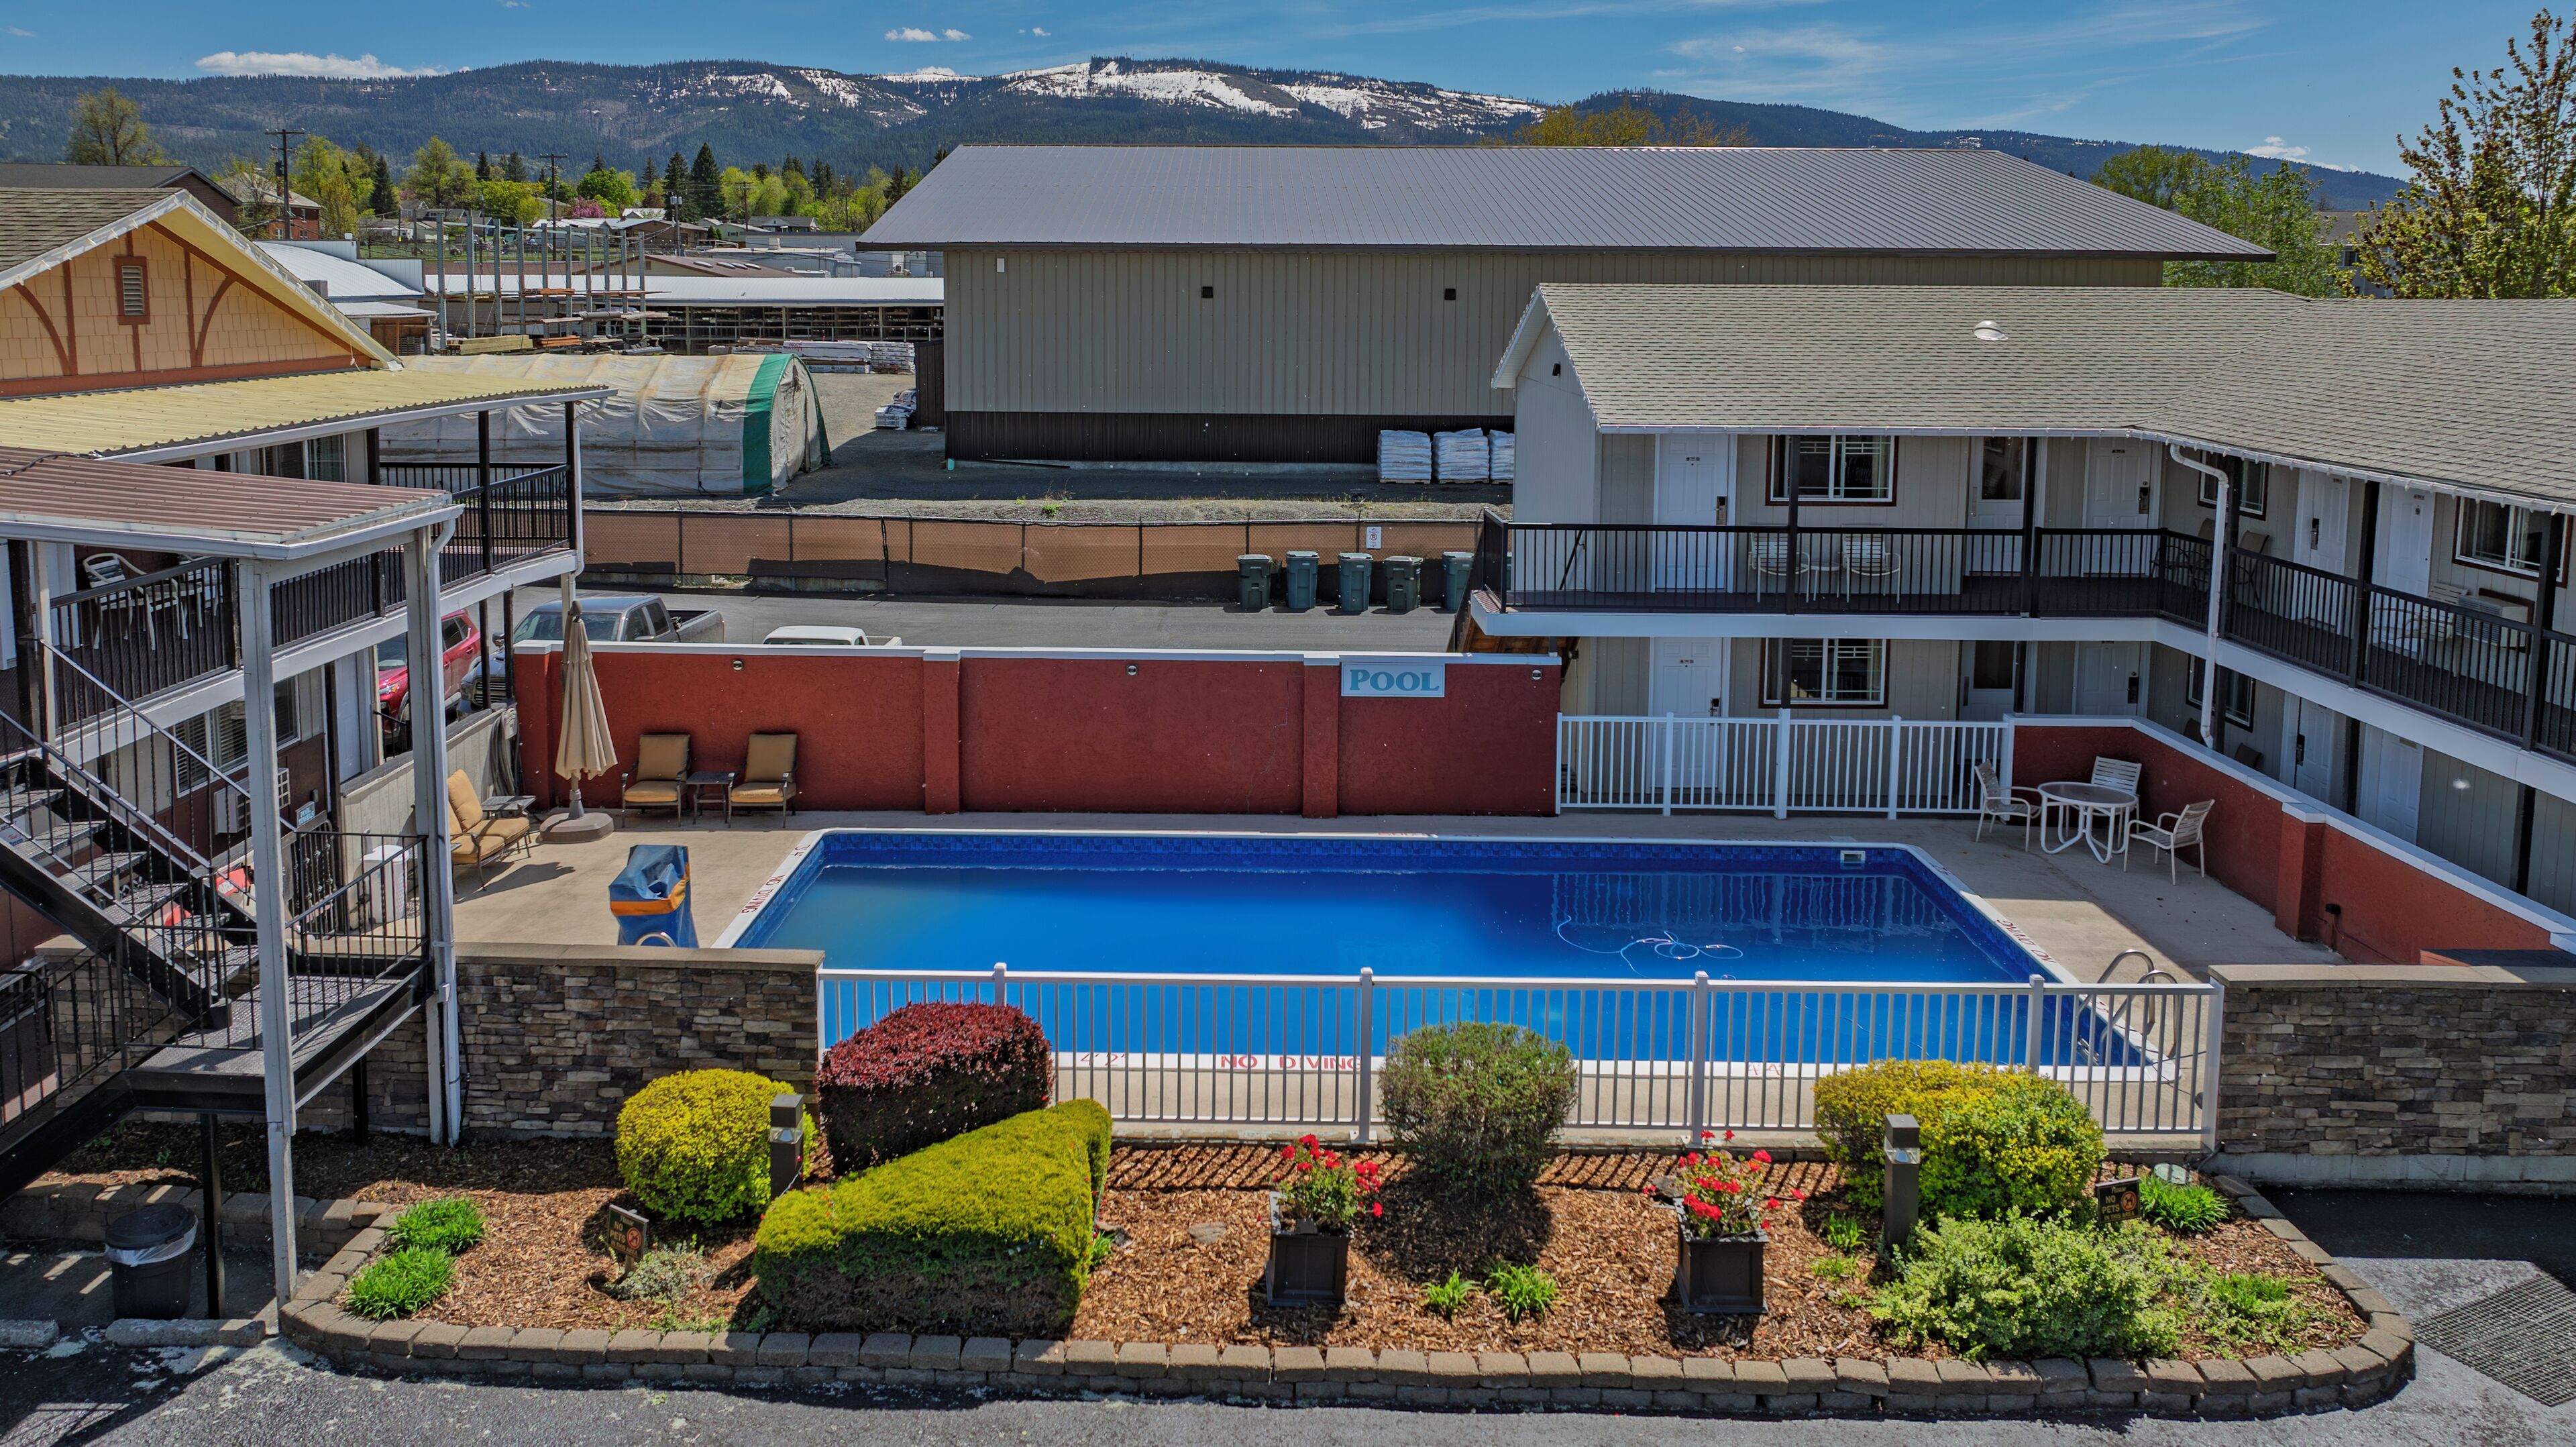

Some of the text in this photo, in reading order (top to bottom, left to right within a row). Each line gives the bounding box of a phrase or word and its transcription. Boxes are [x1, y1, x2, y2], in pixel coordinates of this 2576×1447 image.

[1349, 669, 1440, 692] POOL
[741, 875, 786, 913] NO DIVING
[1996, 920, 2037, 945] DIVING
[1220, 1055, 1258, 1069] NO
[2105, 1195, 2116, 1204] NO
[2102, 1204, 2120, 1214] PETS
[614, 1221, 623, 1231] NO
[610, 1230, 626, 1243] PETS
